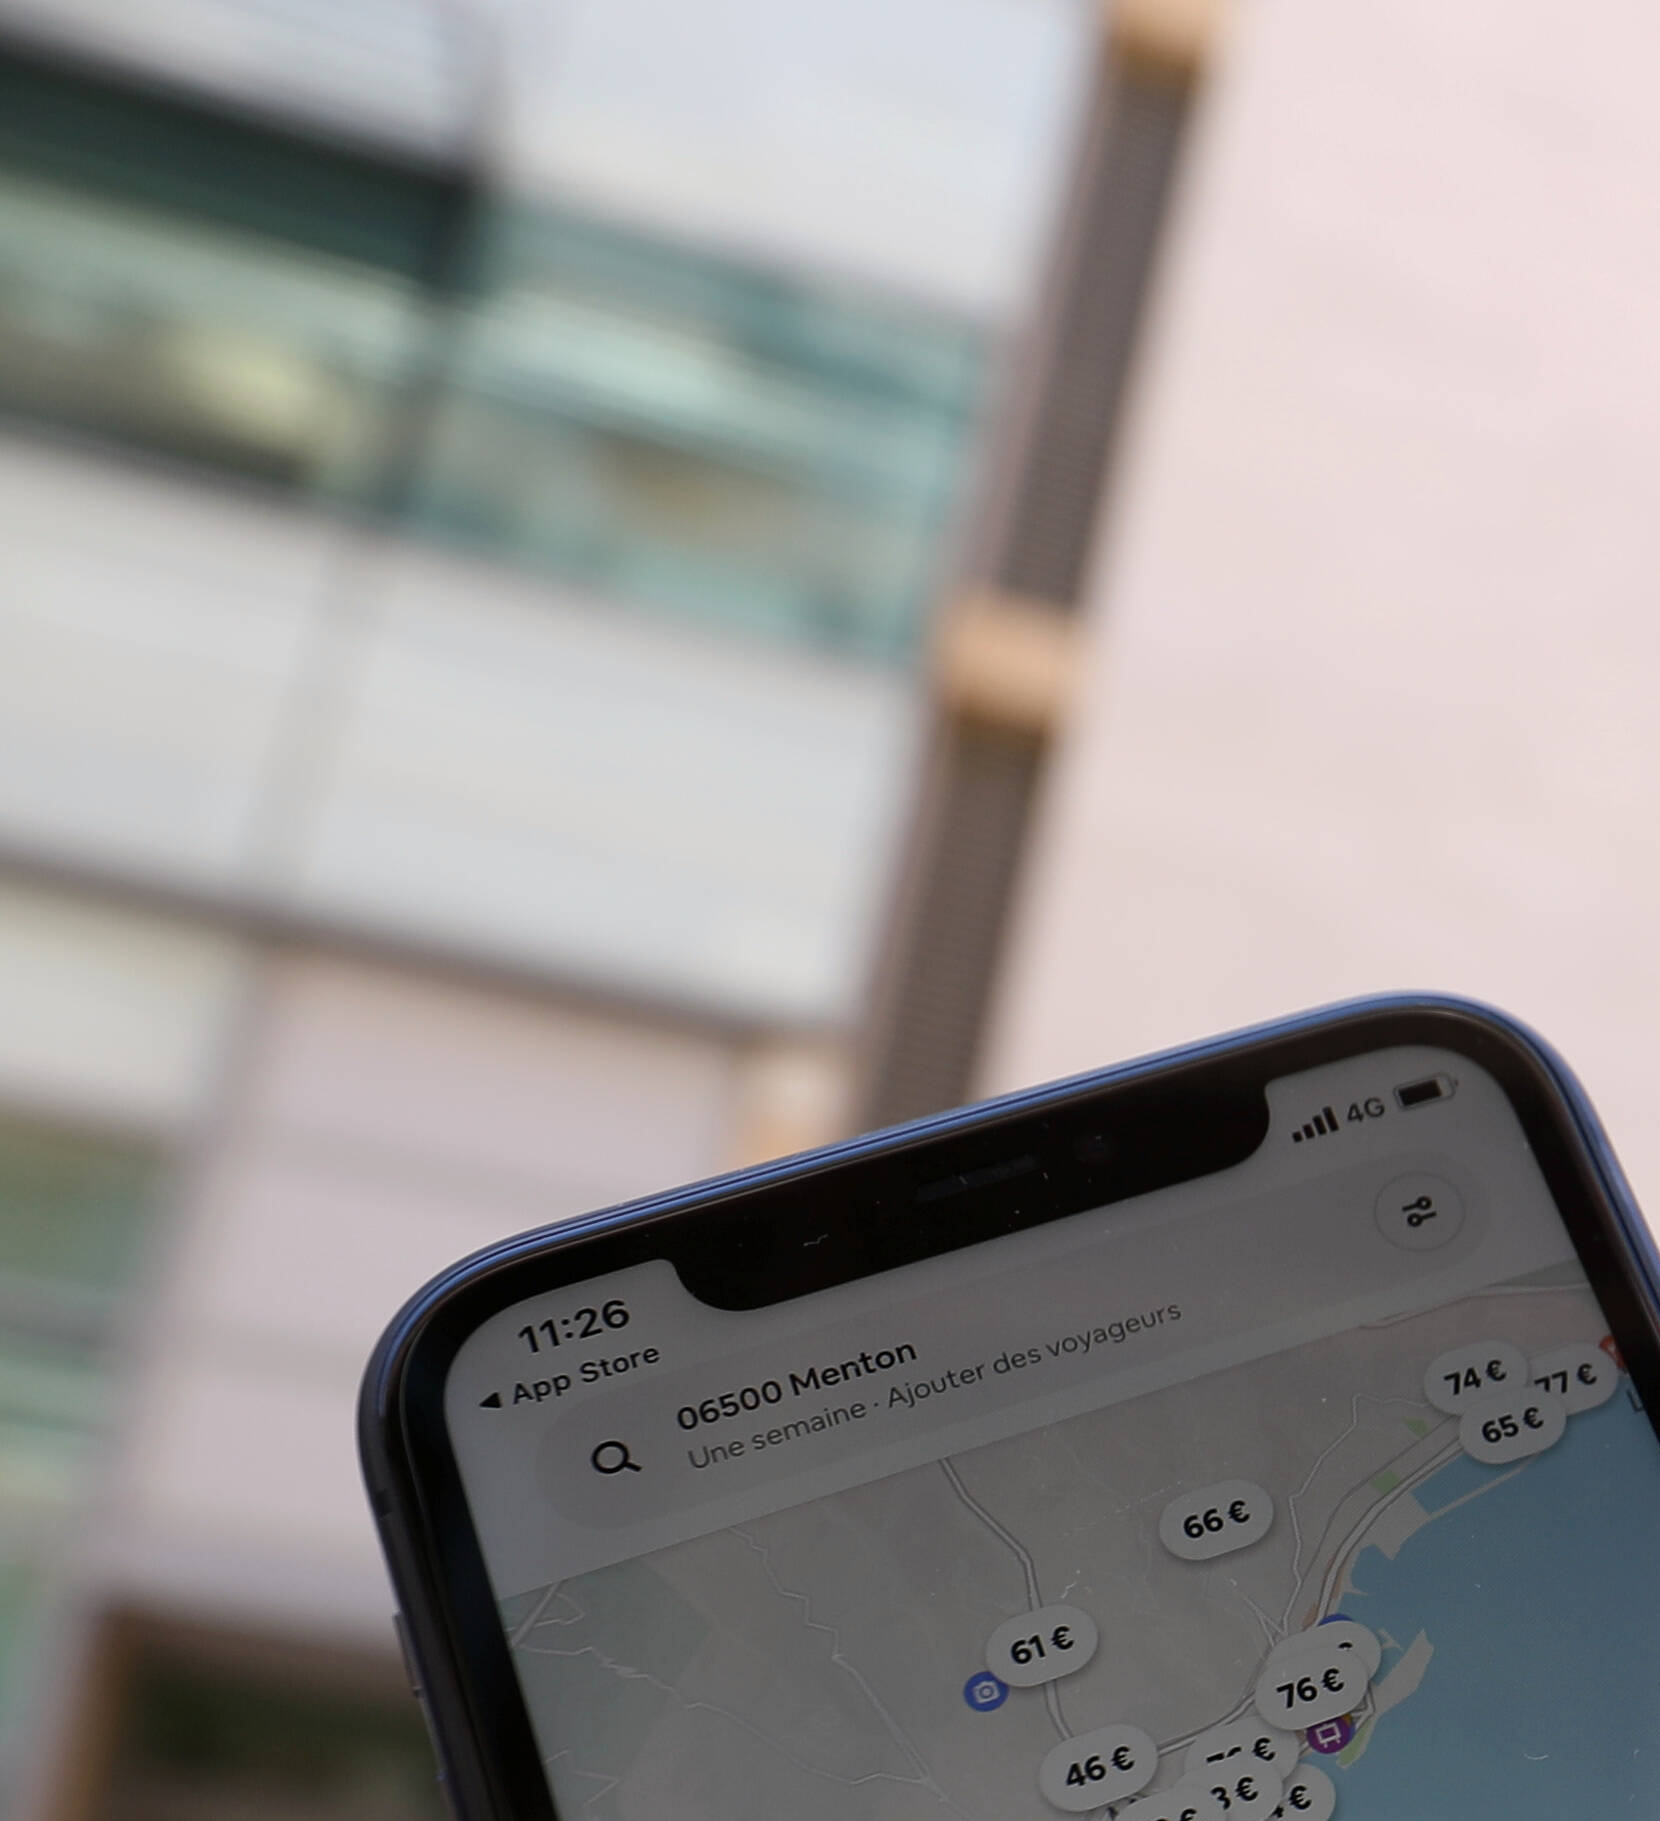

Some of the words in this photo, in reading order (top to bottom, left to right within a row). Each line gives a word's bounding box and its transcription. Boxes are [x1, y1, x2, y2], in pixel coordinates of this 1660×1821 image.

[1346, 1096, 1386, 1123] 4G
[517, 1299, 630, 1353] 11:26
[512, 1374, 572, 1405] App
[579, 1347, 661, 1384] Store
[676, 1381, 783, 1430] 06500
[788, 1343, 918, 1396] Menton
[687, 1440, 746, 1470] Une
[751, 1402, 868, 1450] semaine
[888, 1362, 986, 1408] Ajouter
[992, 1347, 1042, 1375] des
[1045, 1304, 1182, 1356] voyageurs
